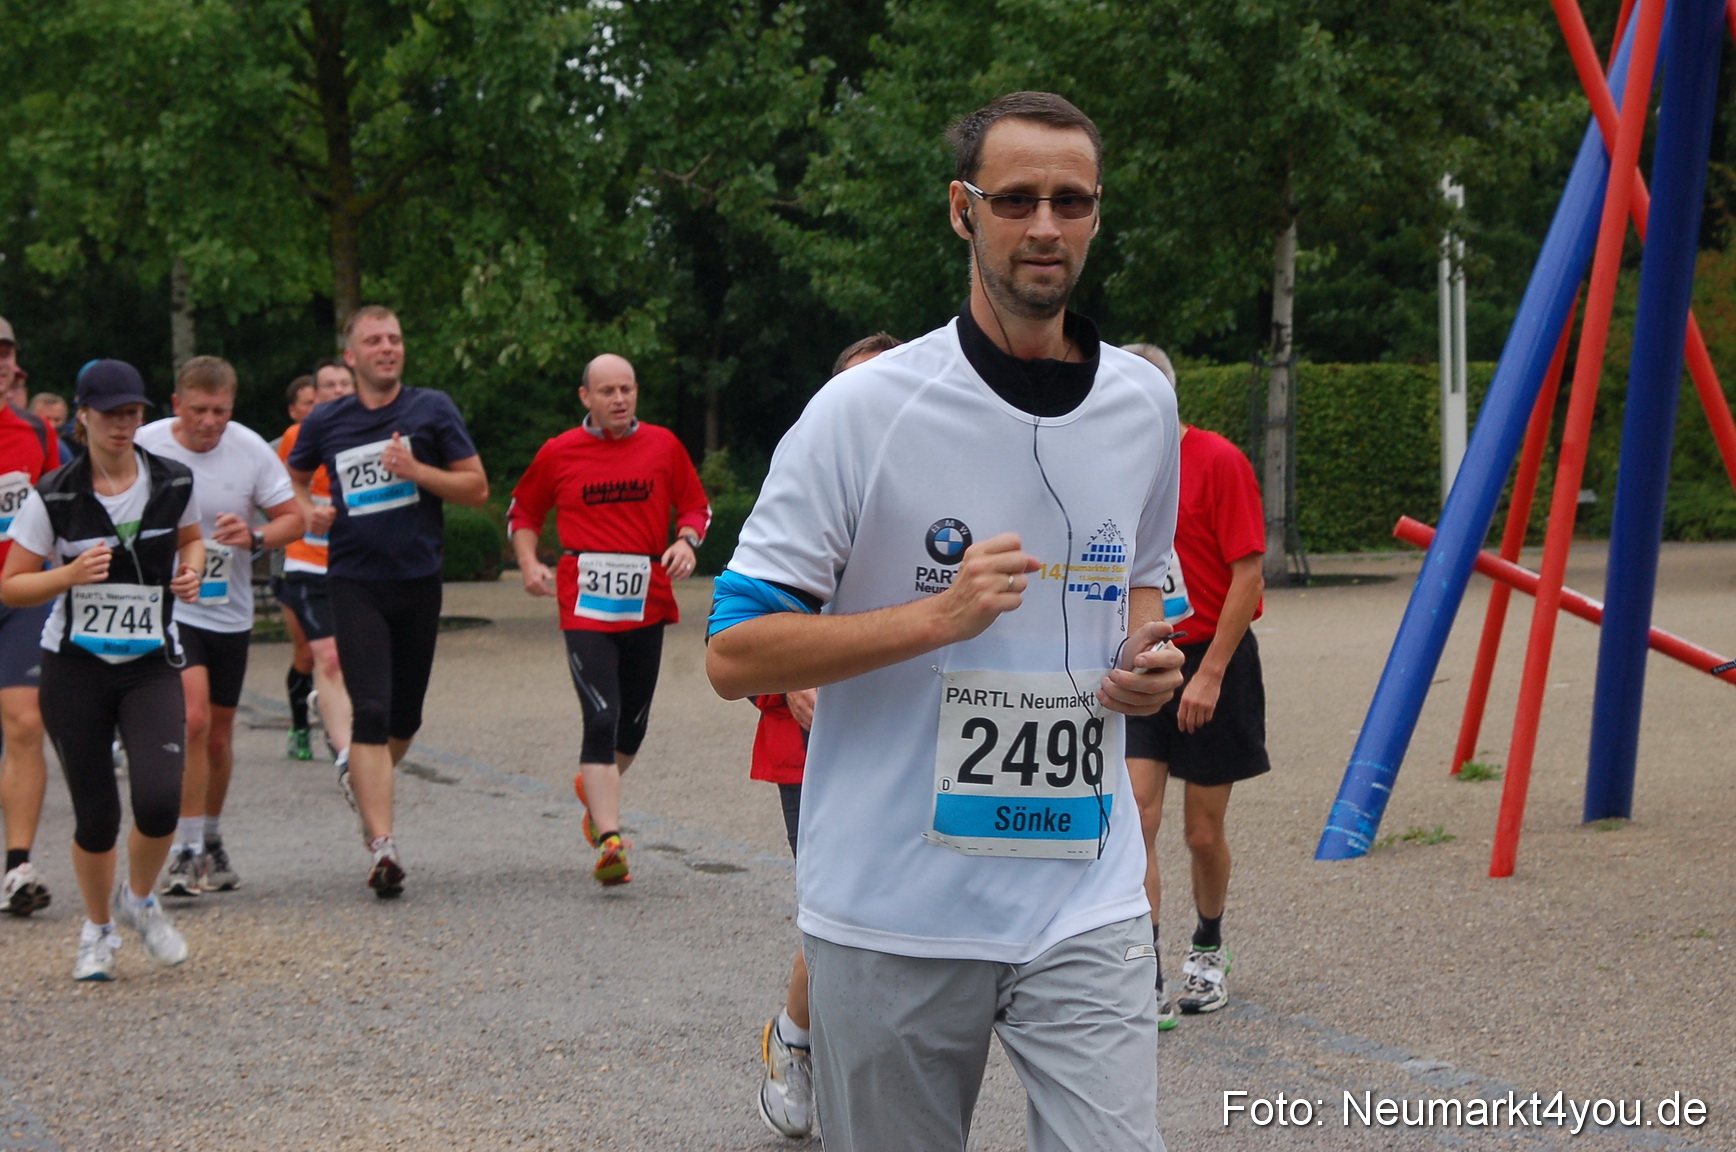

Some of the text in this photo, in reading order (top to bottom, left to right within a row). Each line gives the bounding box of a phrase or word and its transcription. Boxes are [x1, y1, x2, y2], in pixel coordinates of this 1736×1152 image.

[347, 460, 393, 489] 253
[586, 570, 643, 596] 3150
[916, 566, 958, 584] PAR
[83, 604, 153, 634] 2744
[946, 687, 1095, 710] PARTL Neumarkt
[957, 716, 1104, 788] 2498
[942, 779, 950, 791] D
[994, 805, 1071, 833] Sönke
